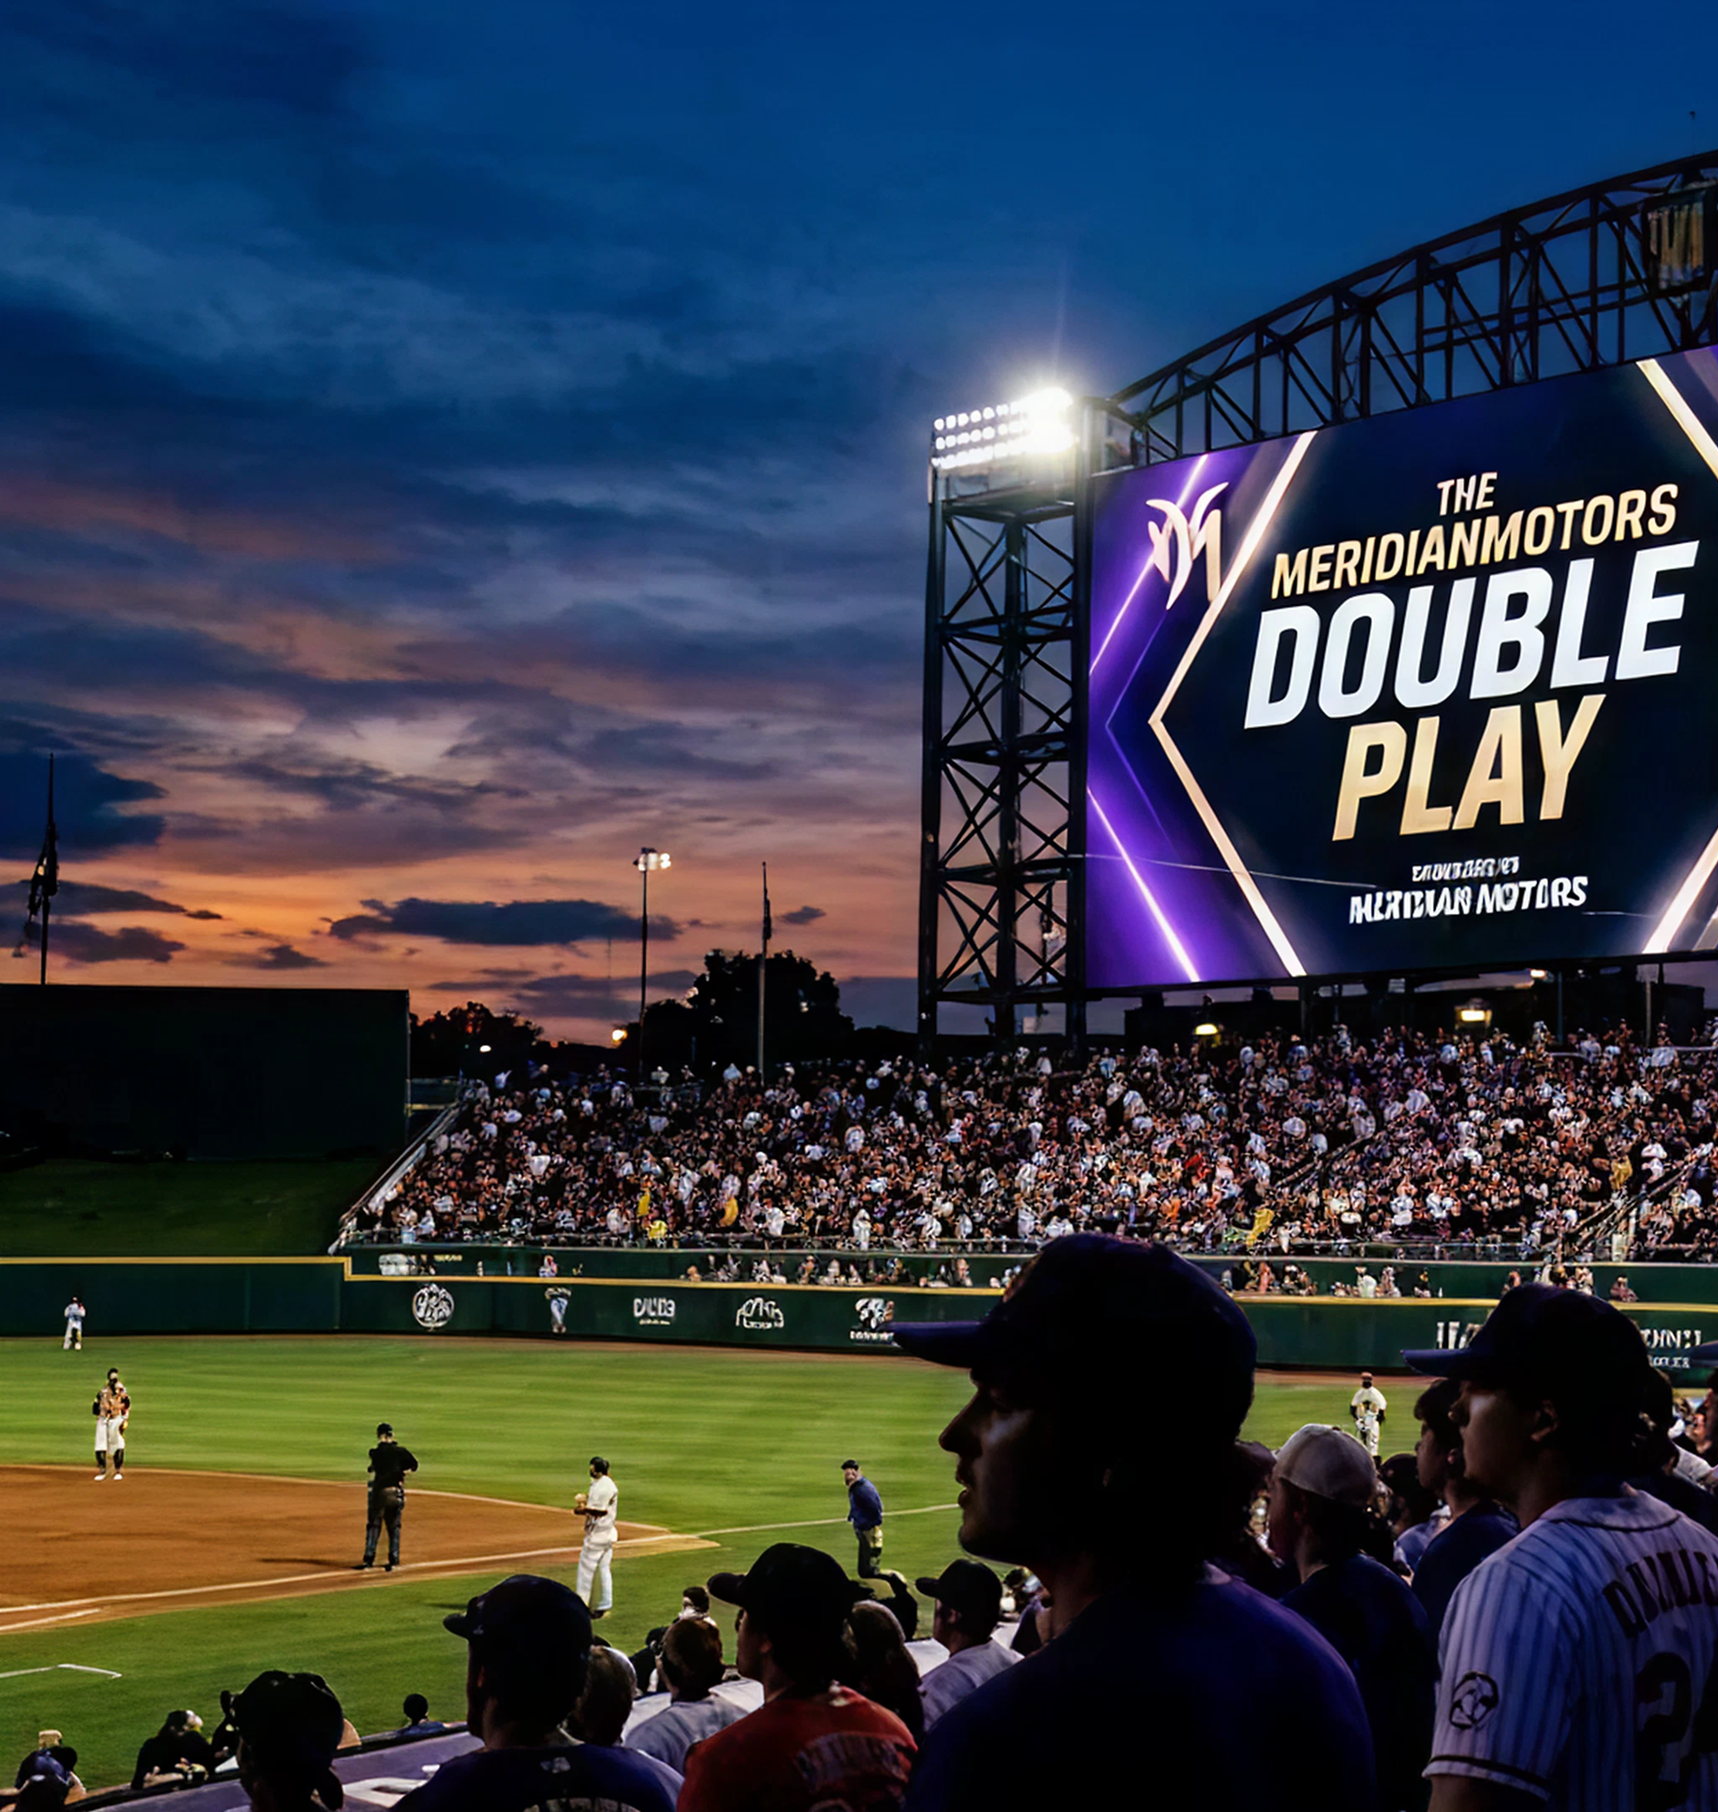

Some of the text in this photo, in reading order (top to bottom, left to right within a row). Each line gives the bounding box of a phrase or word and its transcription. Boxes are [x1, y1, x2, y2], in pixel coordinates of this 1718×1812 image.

[1271, 484, 1680, 600] MERIDIANMOTORS
[1437, 472, 1498, 516] THE
[1244, 540, 1700, 729] DOUBLE
[1332, 694, 1607, 842] PLAY
